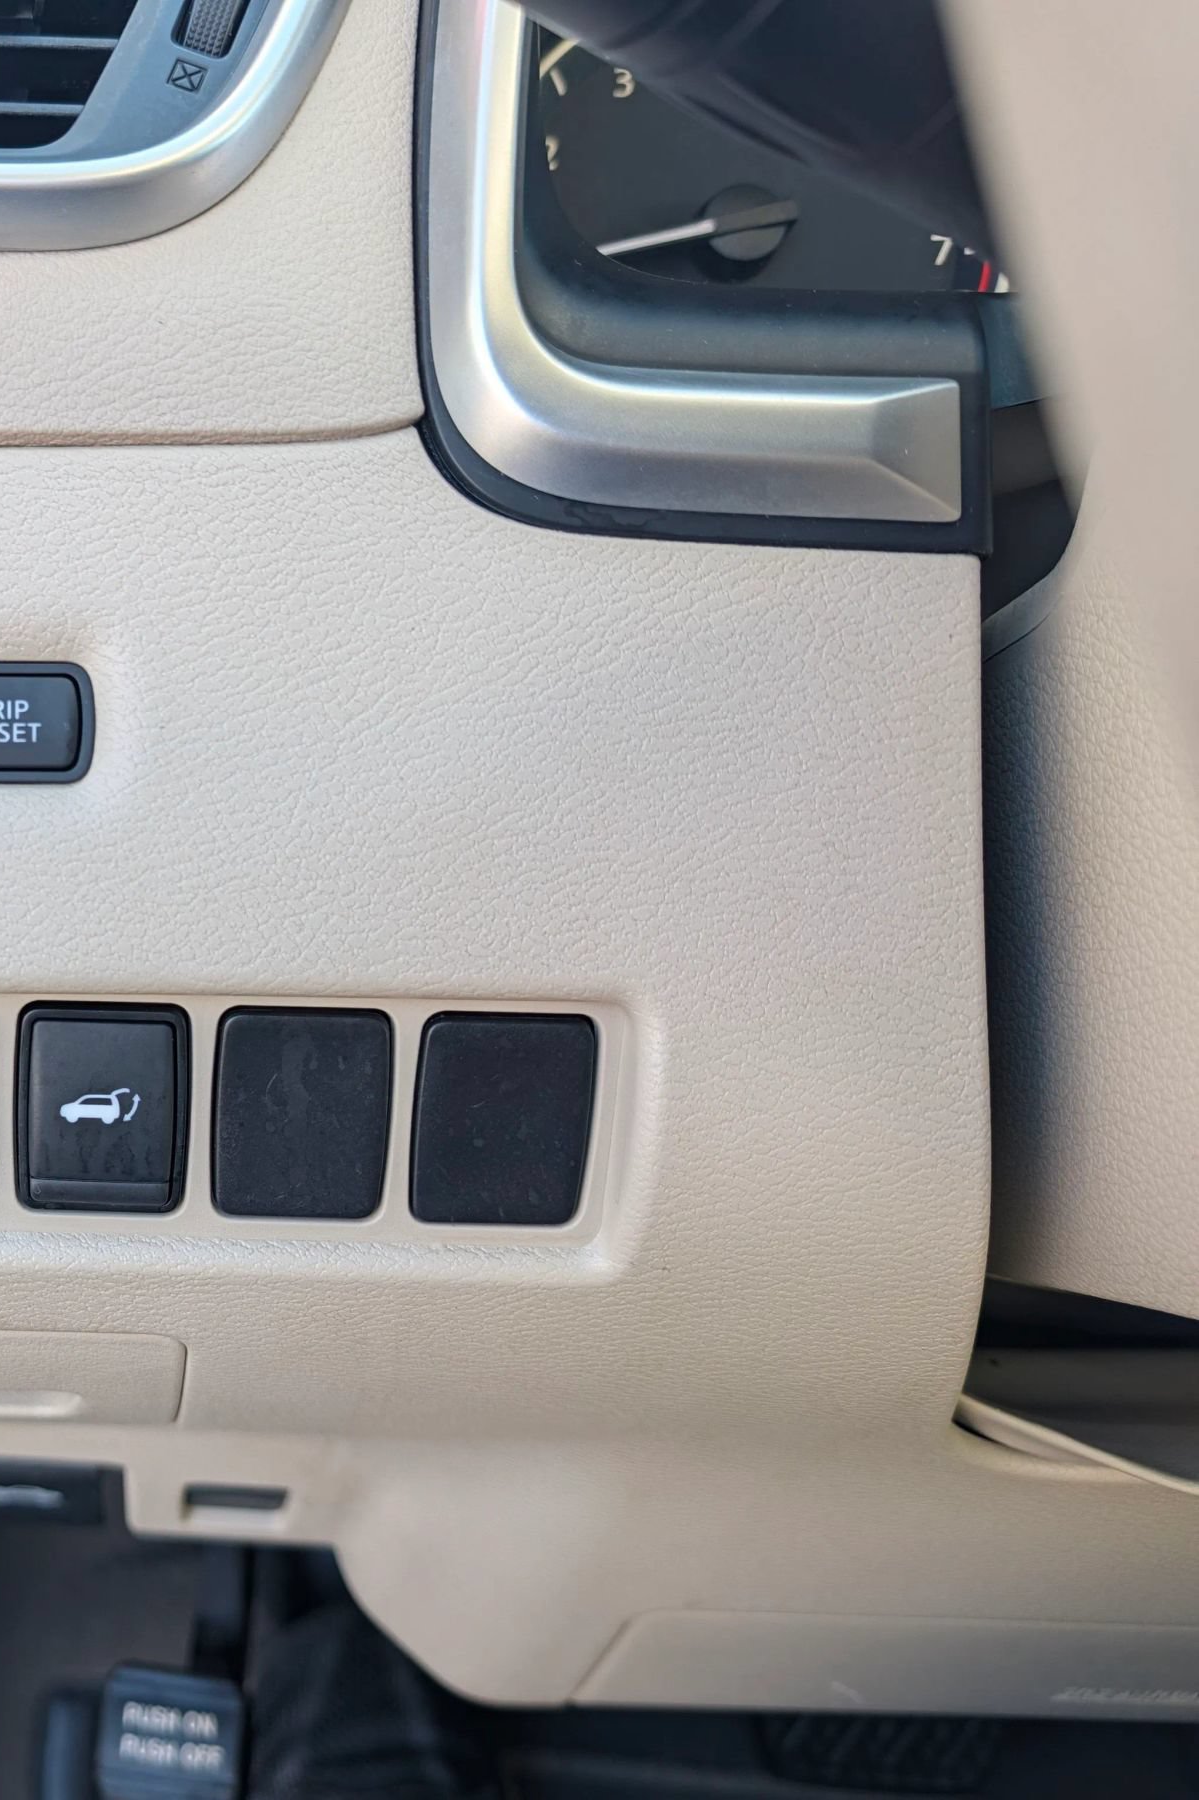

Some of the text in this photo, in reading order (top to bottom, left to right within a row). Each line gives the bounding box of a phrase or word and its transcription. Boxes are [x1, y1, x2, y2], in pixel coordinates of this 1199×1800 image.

[612, 67, 636, 98] 3
[930, 234, 953, 266] 7
[122, 1700, 219, 1738] PUSH ON
[119, 1732, 226, 1770] PUSH OFF
